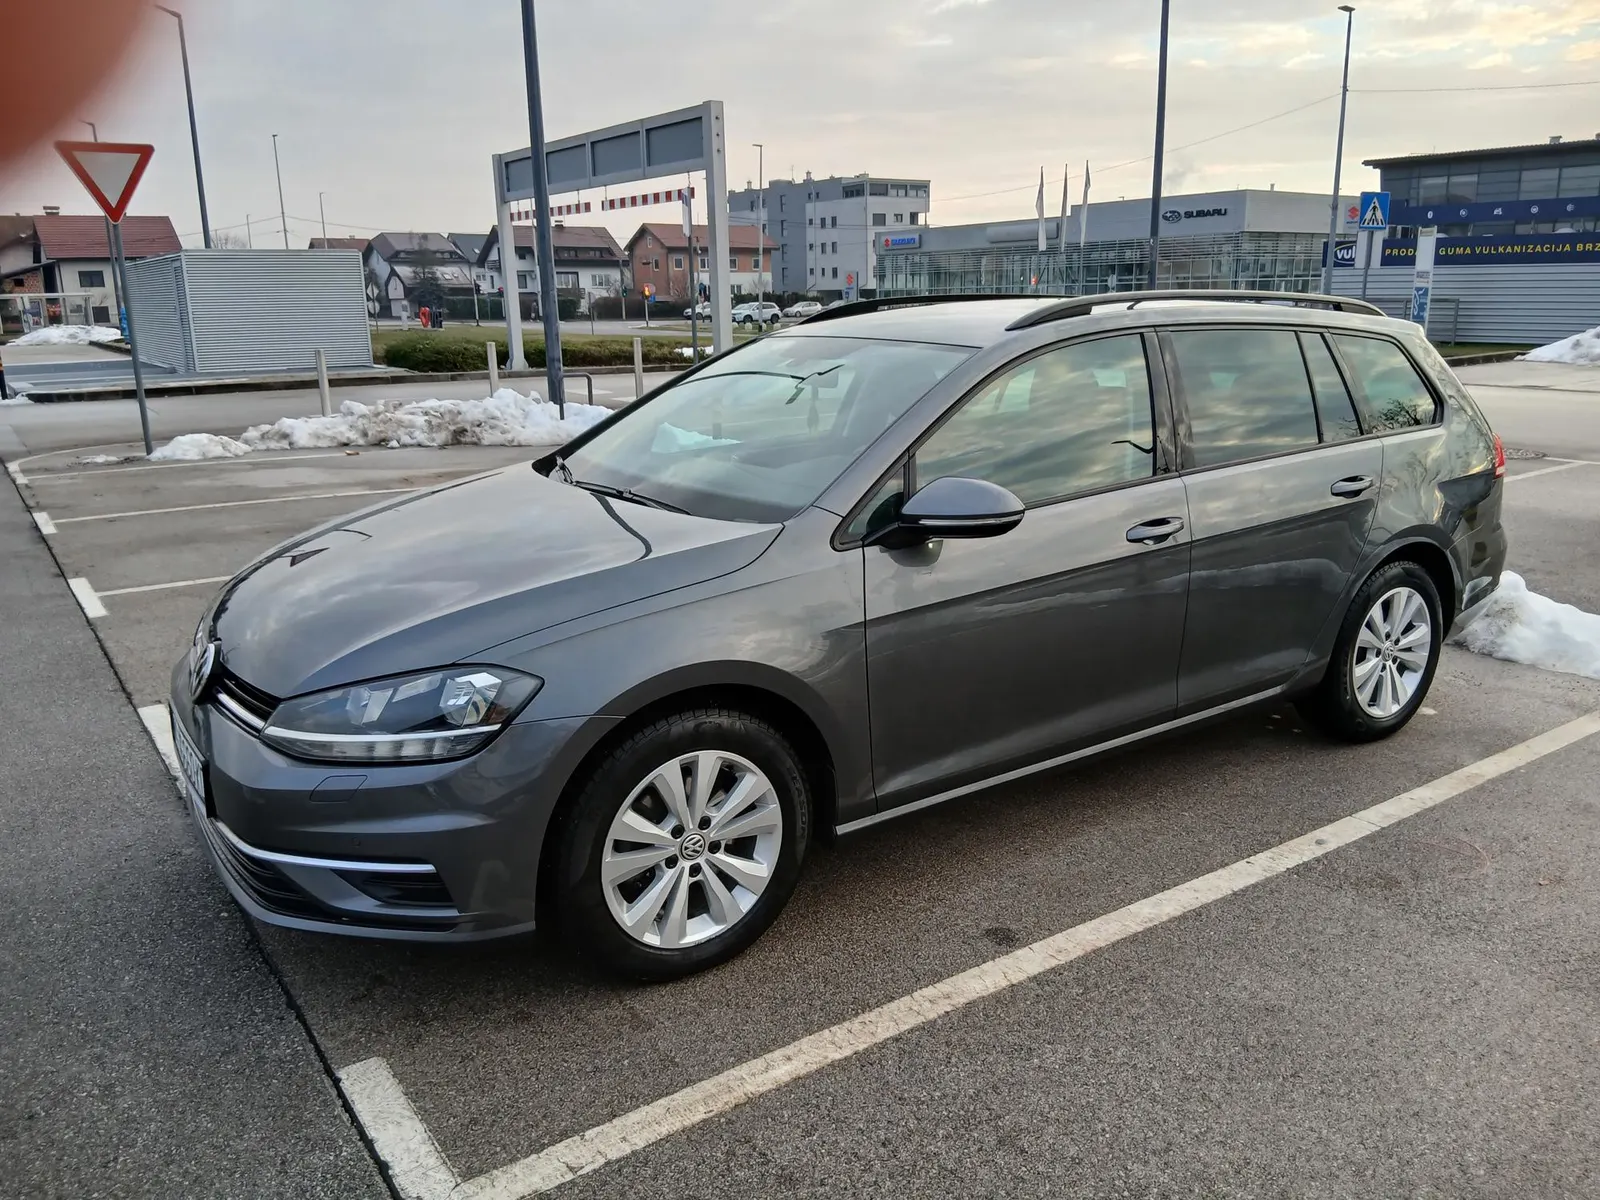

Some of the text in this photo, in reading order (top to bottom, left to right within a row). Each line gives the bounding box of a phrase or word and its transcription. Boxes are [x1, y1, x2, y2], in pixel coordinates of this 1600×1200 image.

[1184, 208, 1228, 219] SUBARU
[1385, 243, 1600, 257] PROD GUMA VULKANIZACIJA BRZ
